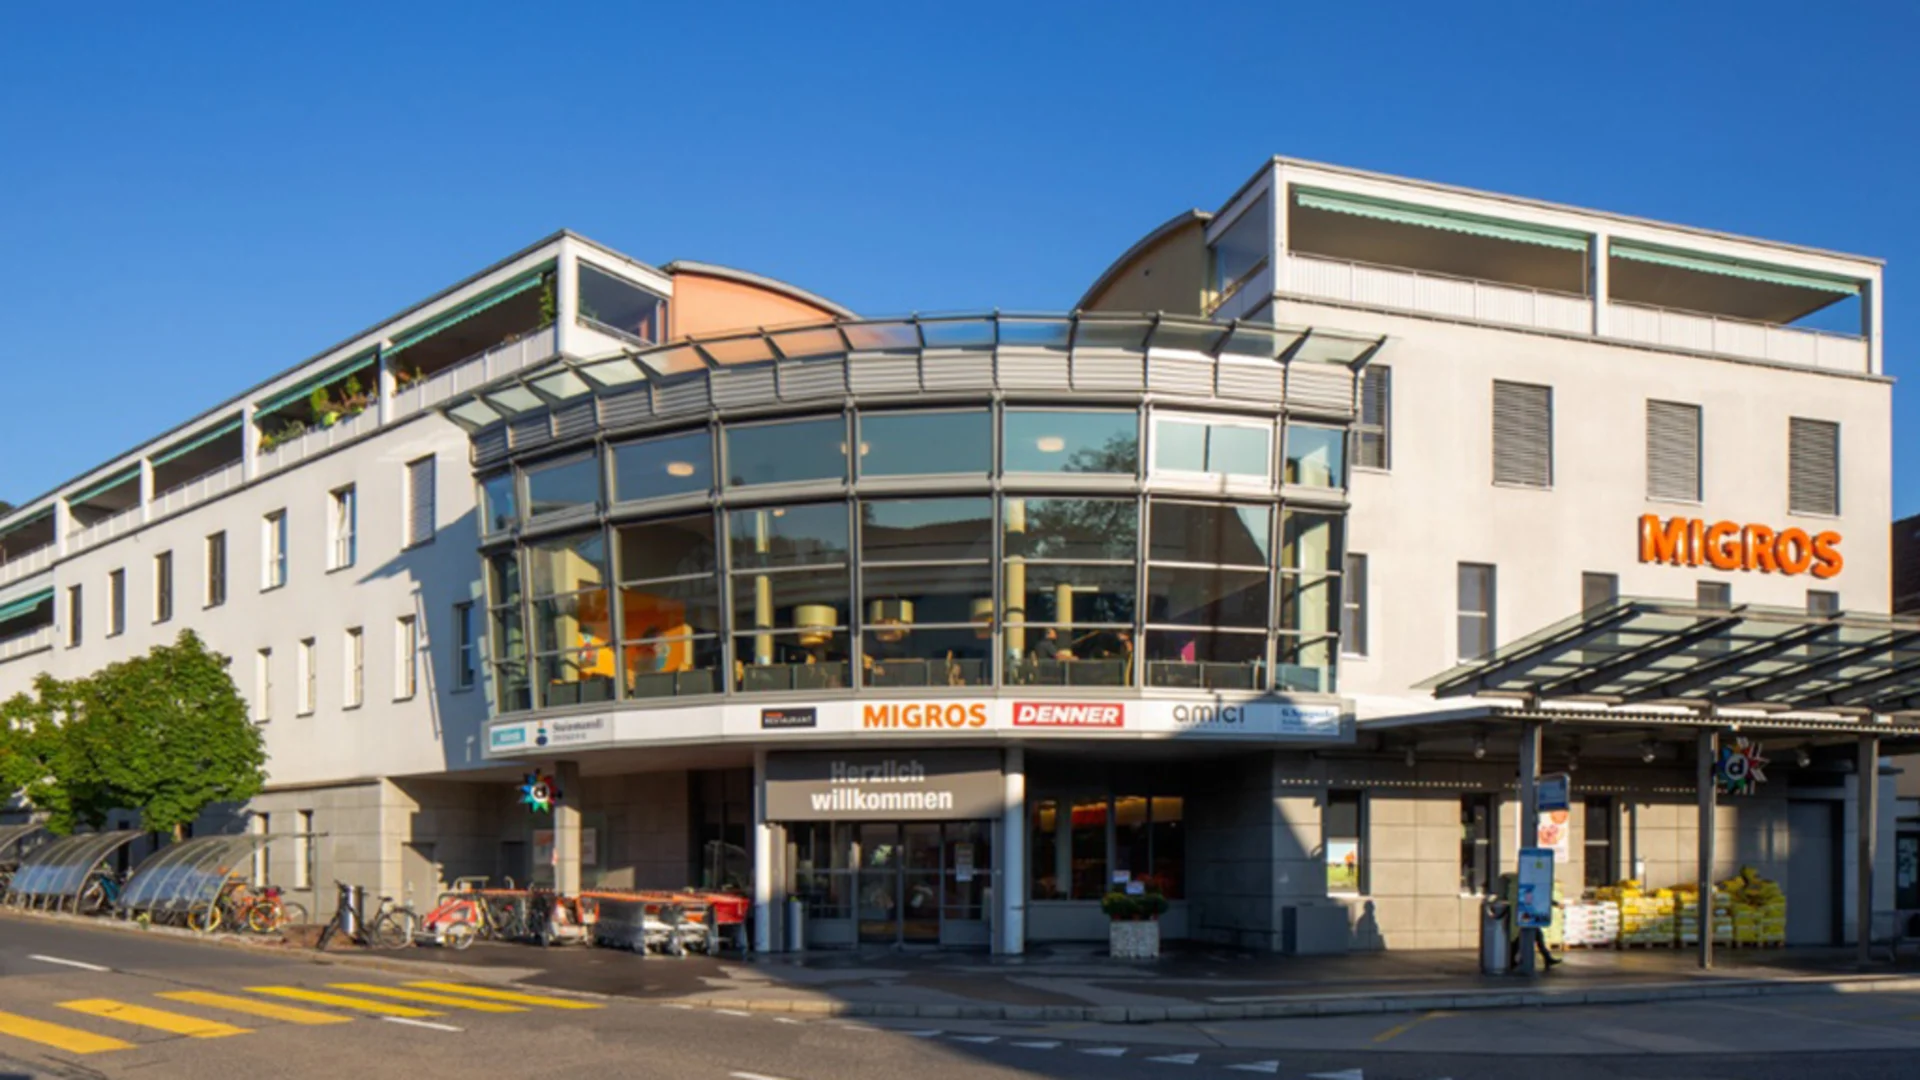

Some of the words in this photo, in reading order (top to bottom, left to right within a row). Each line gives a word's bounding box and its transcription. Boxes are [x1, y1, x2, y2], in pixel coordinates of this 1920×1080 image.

[1639, 513, 1843, 578] MIGROS
[863, 703, 987, 728] MIGROS
[1018, 705, 1121, 724] DENNER
[1173, 703, 1245, 724] amici
[830, 760, 925, 783] Herzlich
[811, 788, 952, 810] willkommen
